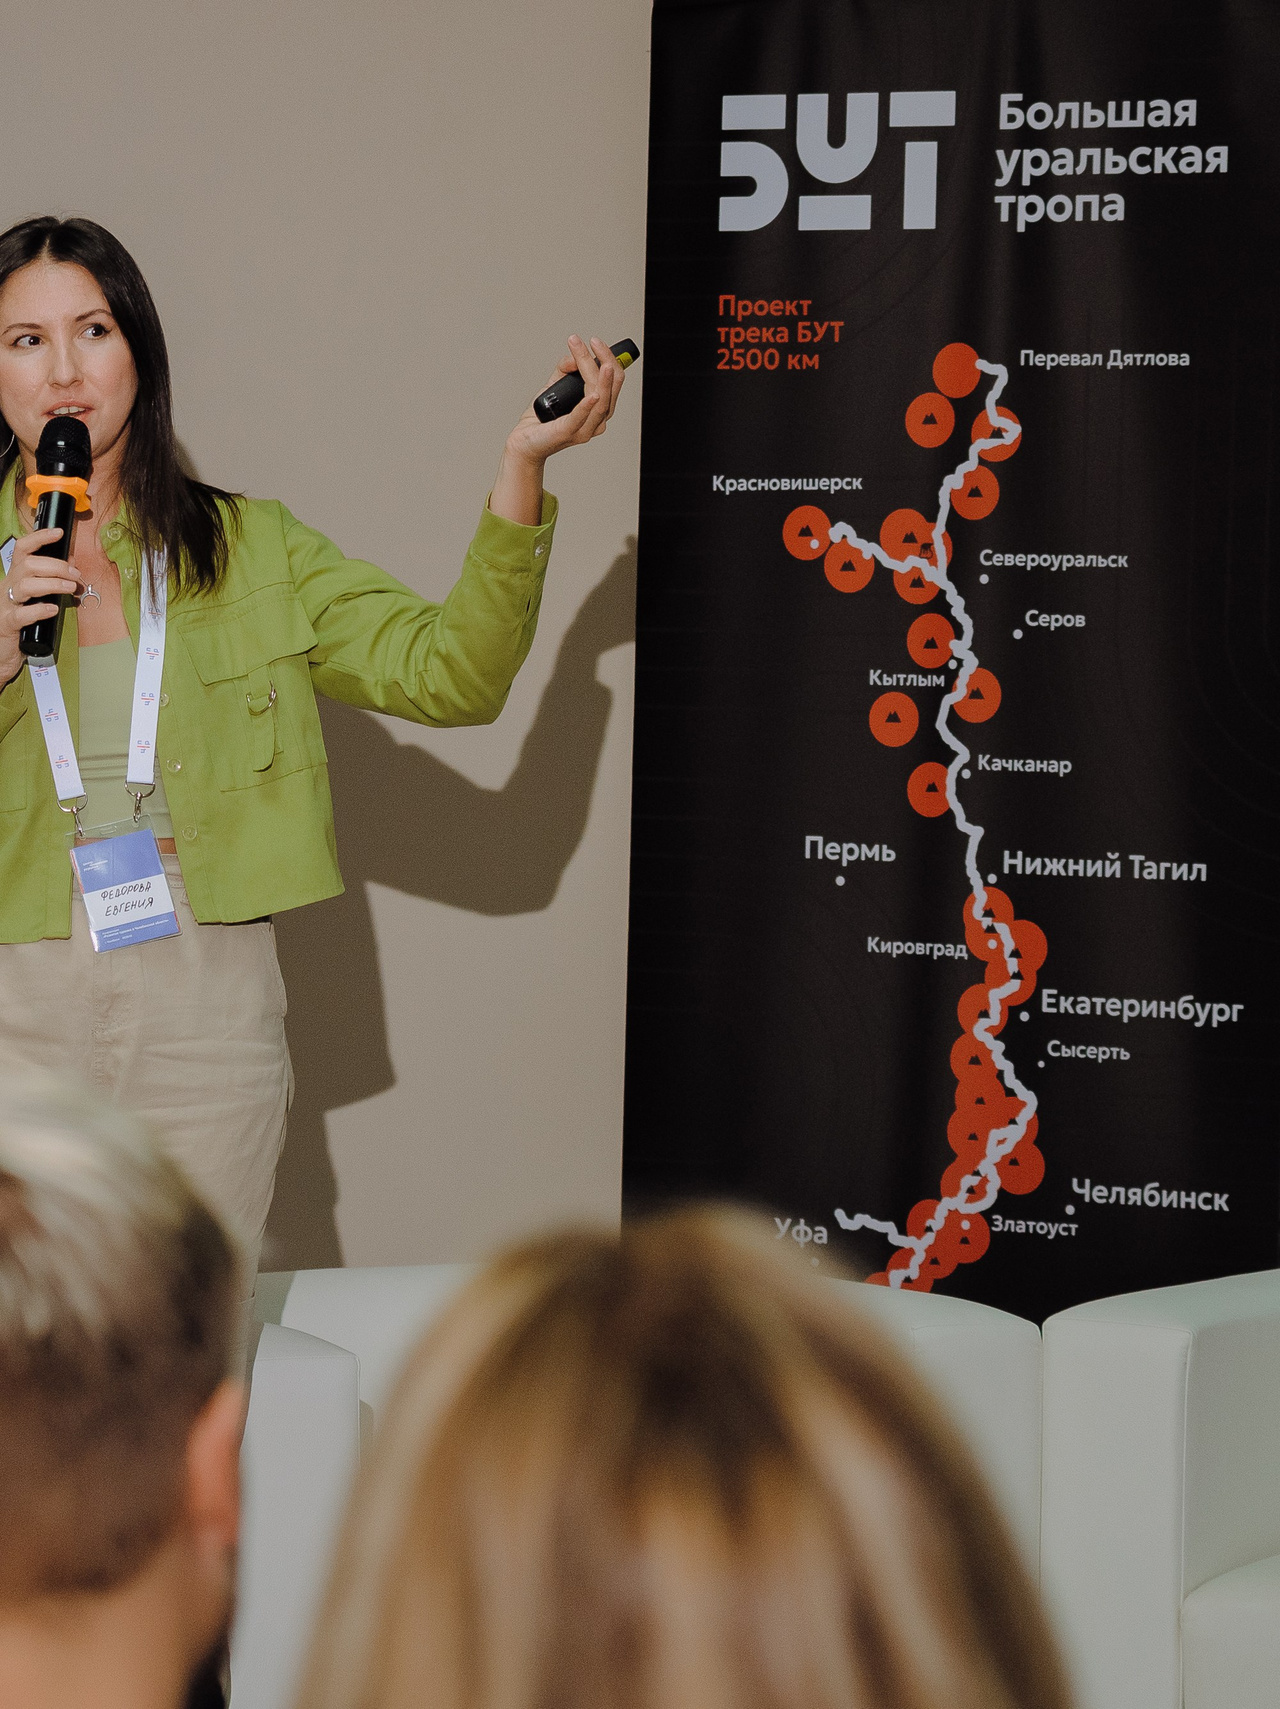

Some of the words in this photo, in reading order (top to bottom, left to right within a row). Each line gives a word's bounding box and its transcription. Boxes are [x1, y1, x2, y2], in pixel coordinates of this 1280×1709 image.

[999, 93, 1197, 130] Большая
[718, 90, 957, 232] БУТ
[994, 145, 1229, 186] уральская
[994, 193, 1125, 233] тропа
[718, 295, 812, 319] Проект
[717, 325, 789, 346] трека
[797, 321, 844, 343] БУТ
[716, 347, 780, 371] 2500
[787, 353, 820, 370] км
[1020, 349, 1103, 371] Перевал
[1106, 350, 1190, 370] Дятлова
[712, 475, 863, 496] Красновишерск
[979, 549, 1129, 571] Североуральск
[1025, 609, 1086, 630] Серов
[868, 669, 946, 688] Кытлым
[977, 754, 1073, 777] Качканар
[804, 835, 897, 867] Пермь
[1002, 850, 1122, 879] Нижний
[1128, 854, 1208, 882] Тагил
[100, 881, 152, 901] ФЕДОРОВА
[104, 896, 155, 917] ЕВГЕНИЯ
[866, 936, 969, 960] Кировград
[1041, 988, 1245, 1028] Екатеринбург
[1046, 1039, 1131, 1063] Сысерть
[1072, 1178, 1230, 1213] Челябинск
[773, 1217, 828, 1248] Уфа
[991, 1214, 1079, 1238] Златоуст
